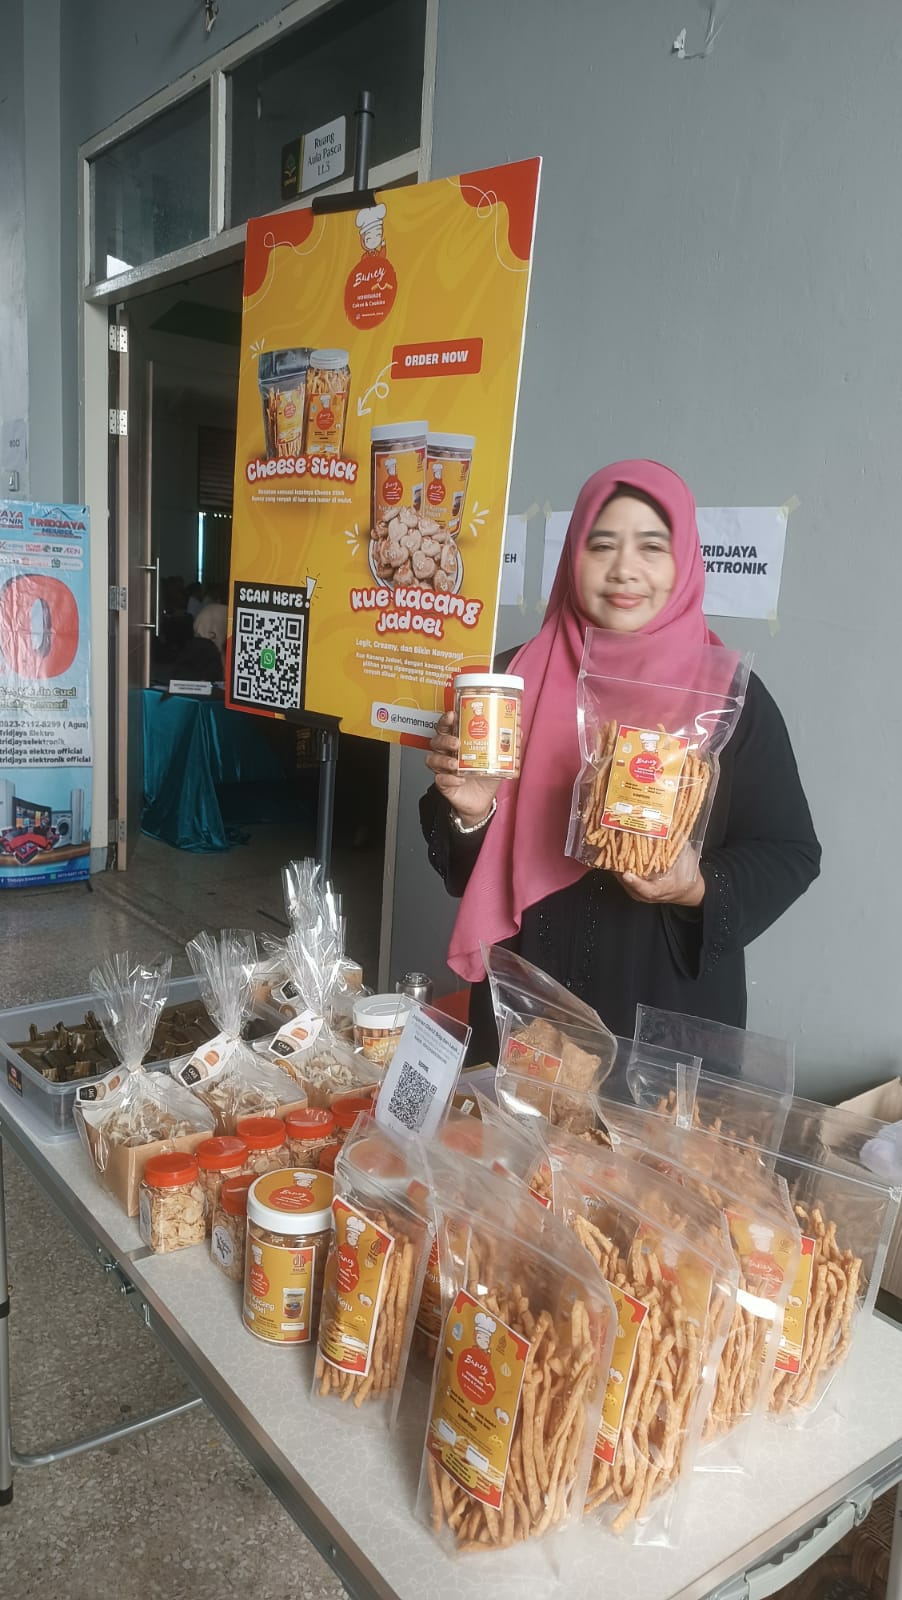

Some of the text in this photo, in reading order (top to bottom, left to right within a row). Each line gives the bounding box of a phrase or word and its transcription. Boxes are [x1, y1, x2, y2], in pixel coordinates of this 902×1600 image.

[314, 133, 335, 150] Ruang
[323, 143, 342, 159] Pasca
[404, 350, 469, 367] ORDER NOW
[28, 517, 87, 531] TRIDJAYA
[240, 588, 270, 604] SCAN
